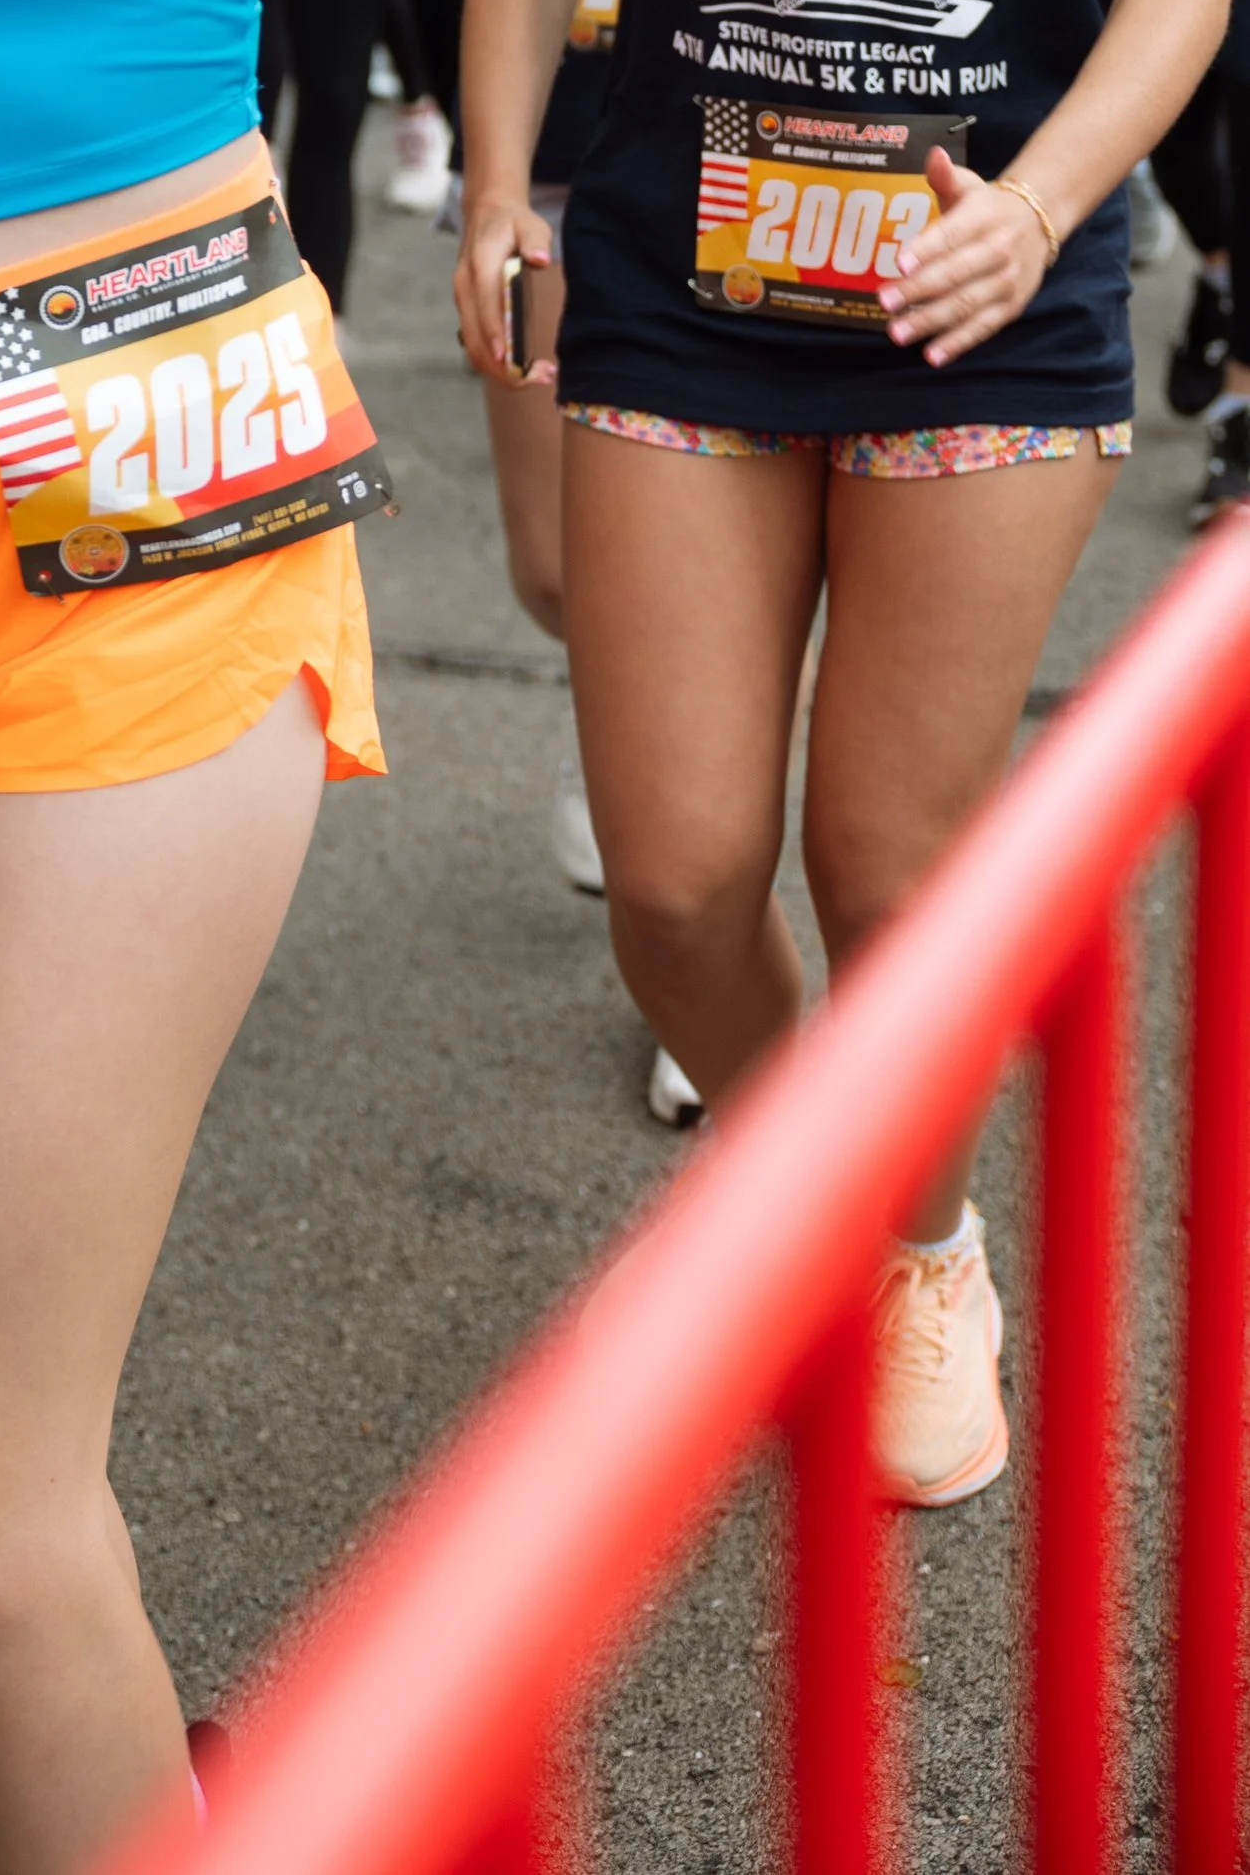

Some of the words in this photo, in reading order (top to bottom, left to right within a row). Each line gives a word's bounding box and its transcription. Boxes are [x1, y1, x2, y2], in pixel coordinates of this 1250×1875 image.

[672, 30, 704, 65] 4TH
[708, 43, 814, 87] ANNUAL
[820, 64, 856, 93] 5K
[864, 68, 885, 94] &
[893, 67, 951, 97] FUN
[959, 61, 1007, 96] RUN
[718, 21, 769, 47] STEVE
[772, 31, 856, 61] PROFFITT
[860, 44, 935, 65] LEGACY
[784, 116, 909, 143] HEARTLAND
[746, 178, 932, 279] 2003
[85, 226, 249, 306] HEARTLAND
[86, 312, 328, 516] 2025
